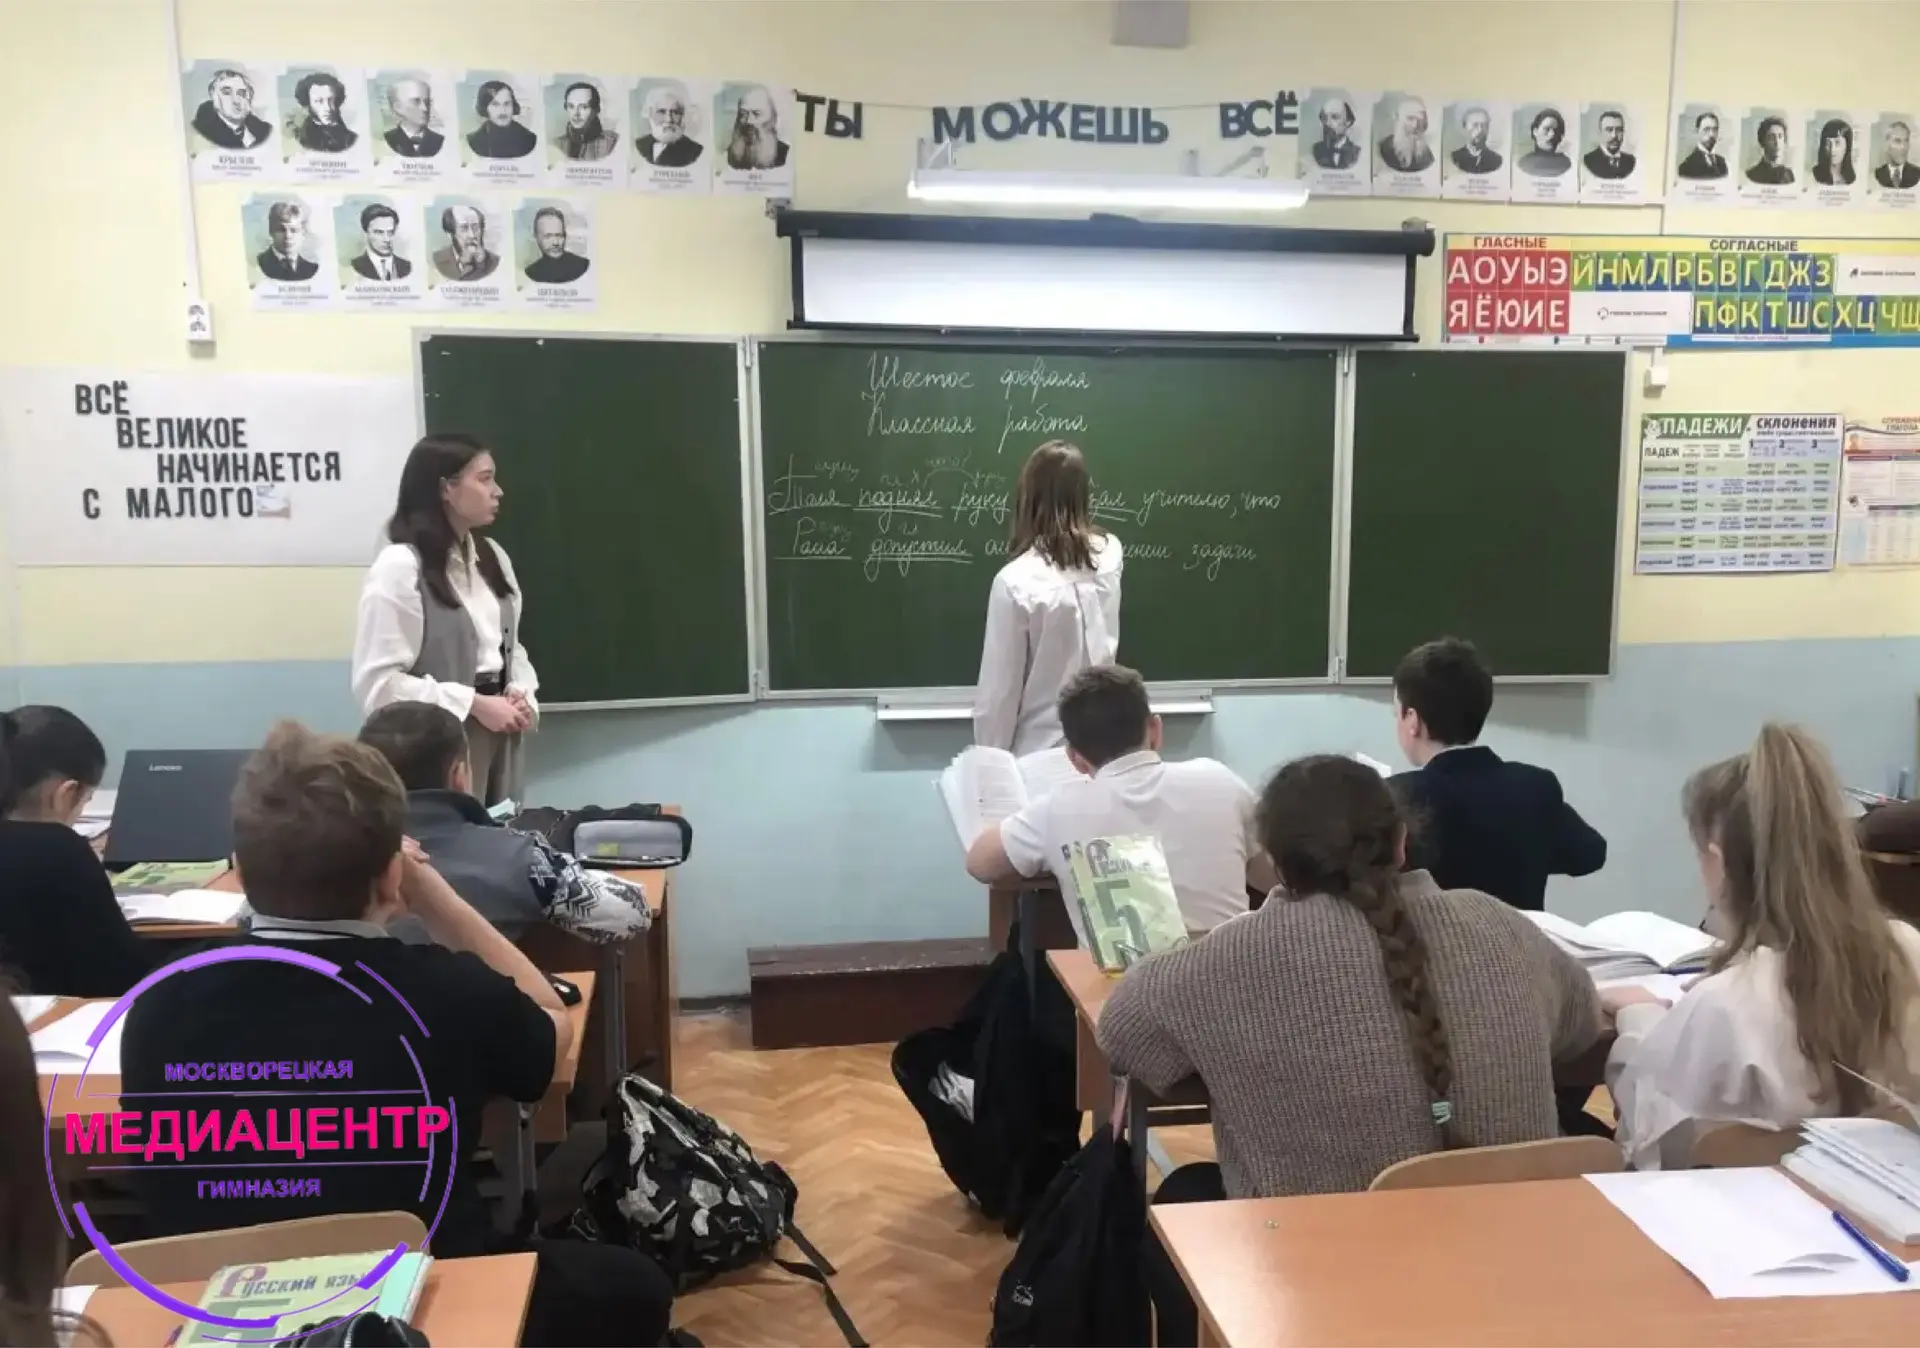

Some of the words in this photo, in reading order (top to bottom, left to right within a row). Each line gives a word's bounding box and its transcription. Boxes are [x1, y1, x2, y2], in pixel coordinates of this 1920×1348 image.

[796, 93, 863, 138] ТЫ
[932, 98, 1169, 144] МОЖЕШЬ
[1219, 91, 1299, 139] ВСЁ
[1473, 236, 1547, 248] ГЛАСНЫЕ
[1709, 239, 1799, 251] СОГЛАСНЫЕ
[75, 380, 130, 415] ВСЁ
[116, 417, 248, 449] ВЕЛИКОЕ
[861, 391, 977, 436] Классная
[998, 403, 1088, 454] работа
[1660, 417, 1743, 436] ПАДЕЖИ
[157, 451, 341, 483] НАЧИНАЕТСЯ
[1644, 447, 1680, 459] ПАДЕЖ
[82, 488, 101, 520] С
[126, 486, 253, 519] МАЛОГО
